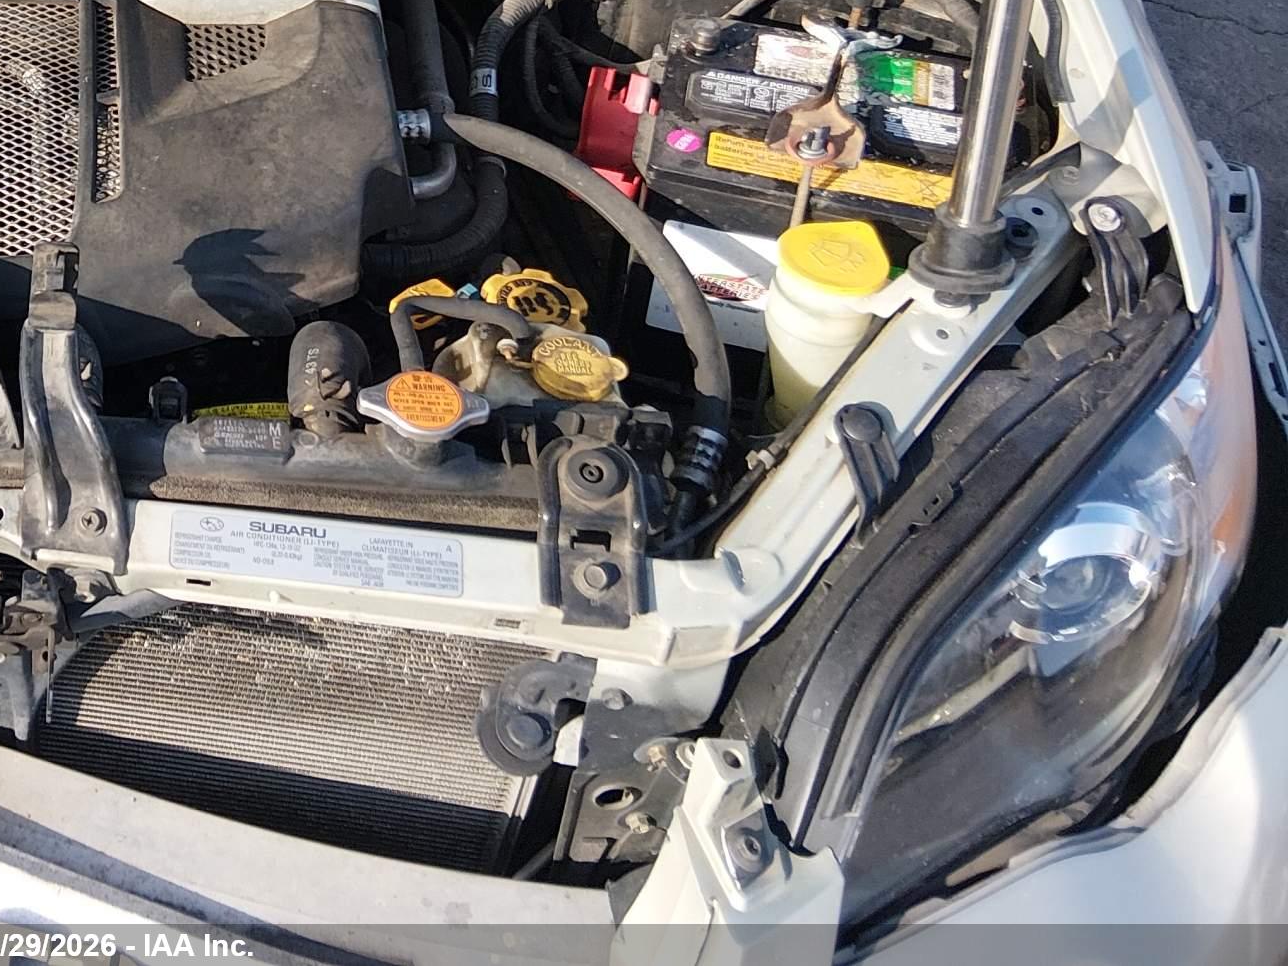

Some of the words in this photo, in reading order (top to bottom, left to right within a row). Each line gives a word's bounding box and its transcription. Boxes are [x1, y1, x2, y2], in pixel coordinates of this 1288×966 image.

[717, 73, 760, 86] DANGER
[770, 81, 810, 94] POISON
[539, 337, 602, 357] COOLANT
[412, 381, 447, 393] WARNING
[269, 422, 281, 436] M
[230, 530, 244, 539] AIR
[246, 532, 302, 545] CONDITIONER
[249, 521, 327, 539] SUBARU
[445, 544, 453, 553] A
